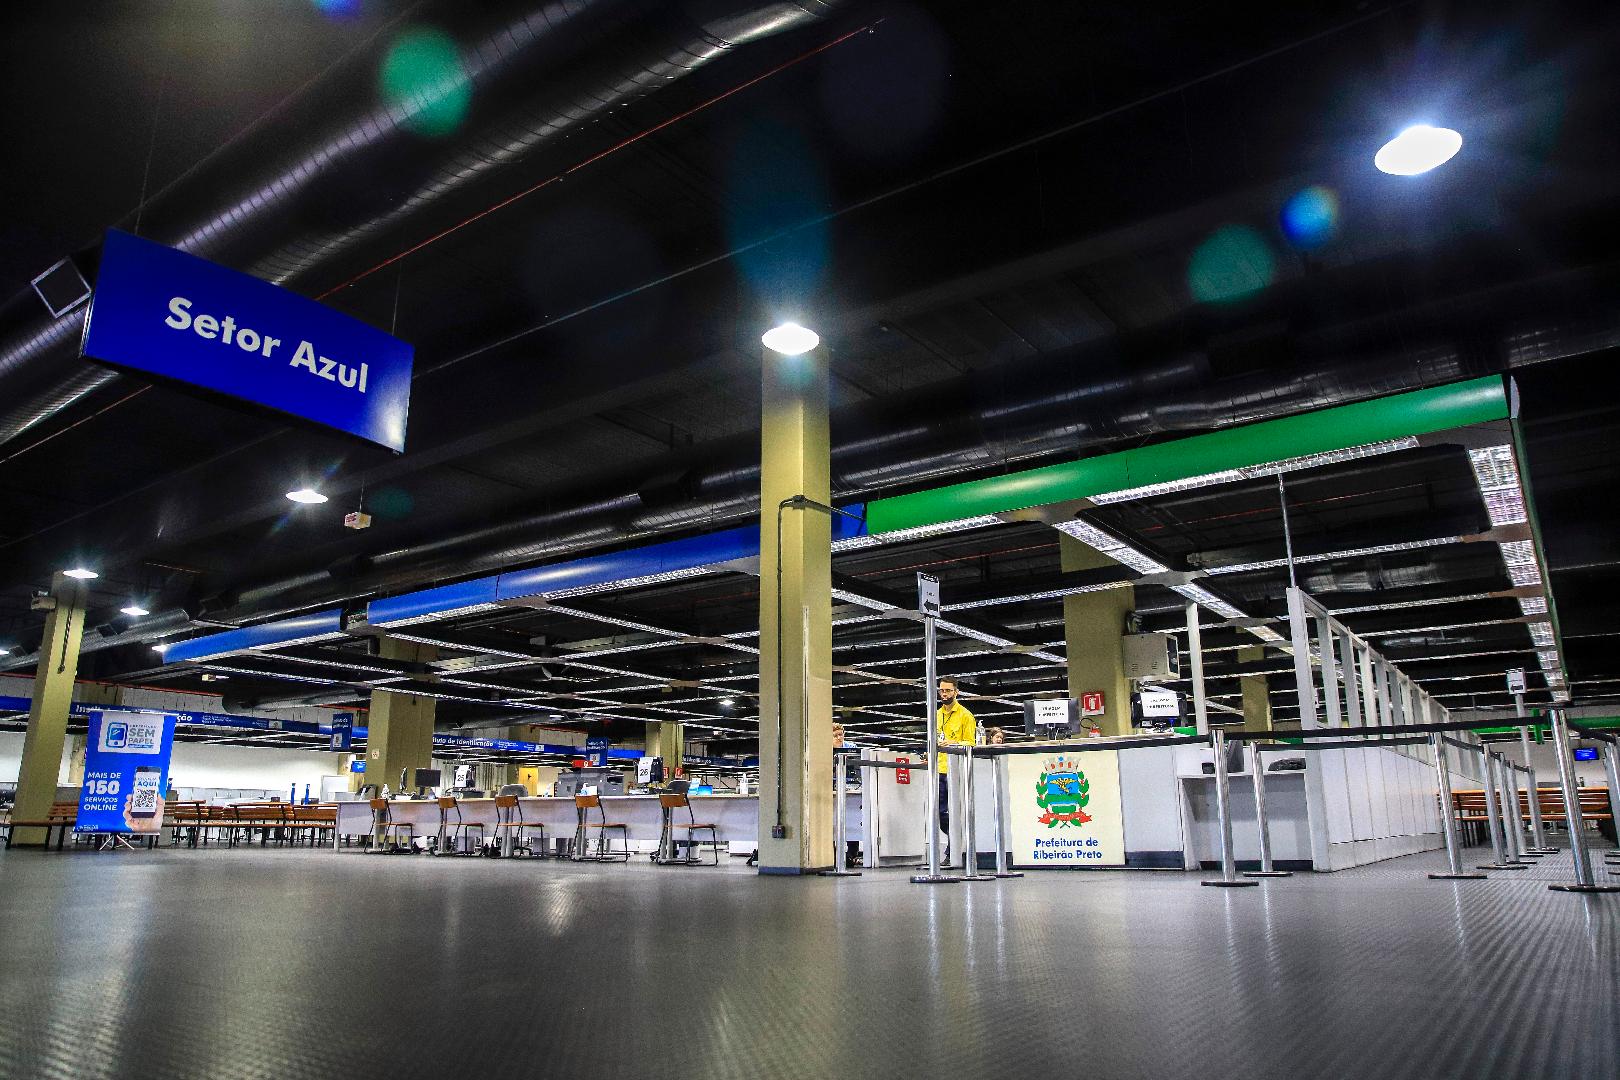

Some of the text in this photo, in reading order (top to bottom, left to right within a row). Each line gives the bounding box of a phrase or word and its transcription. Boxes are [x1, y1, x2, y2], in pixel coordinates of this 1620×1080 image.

[165, 297, 369, 393] Setor Azul
[128, 728, 156, 737] SEM
[128, 737, 155, 745] PAPEL
[457, 774, 465, 782] 25
[85, 779, 120, 795] 150
[84, 796, 118, 804] SERVIÇOS
[83, 803, 118, 811] ONLINE
[1035, 837, 1099, 848] Prefeitura de
[1033, 850, 1103, 860] Ribeirão Preto
